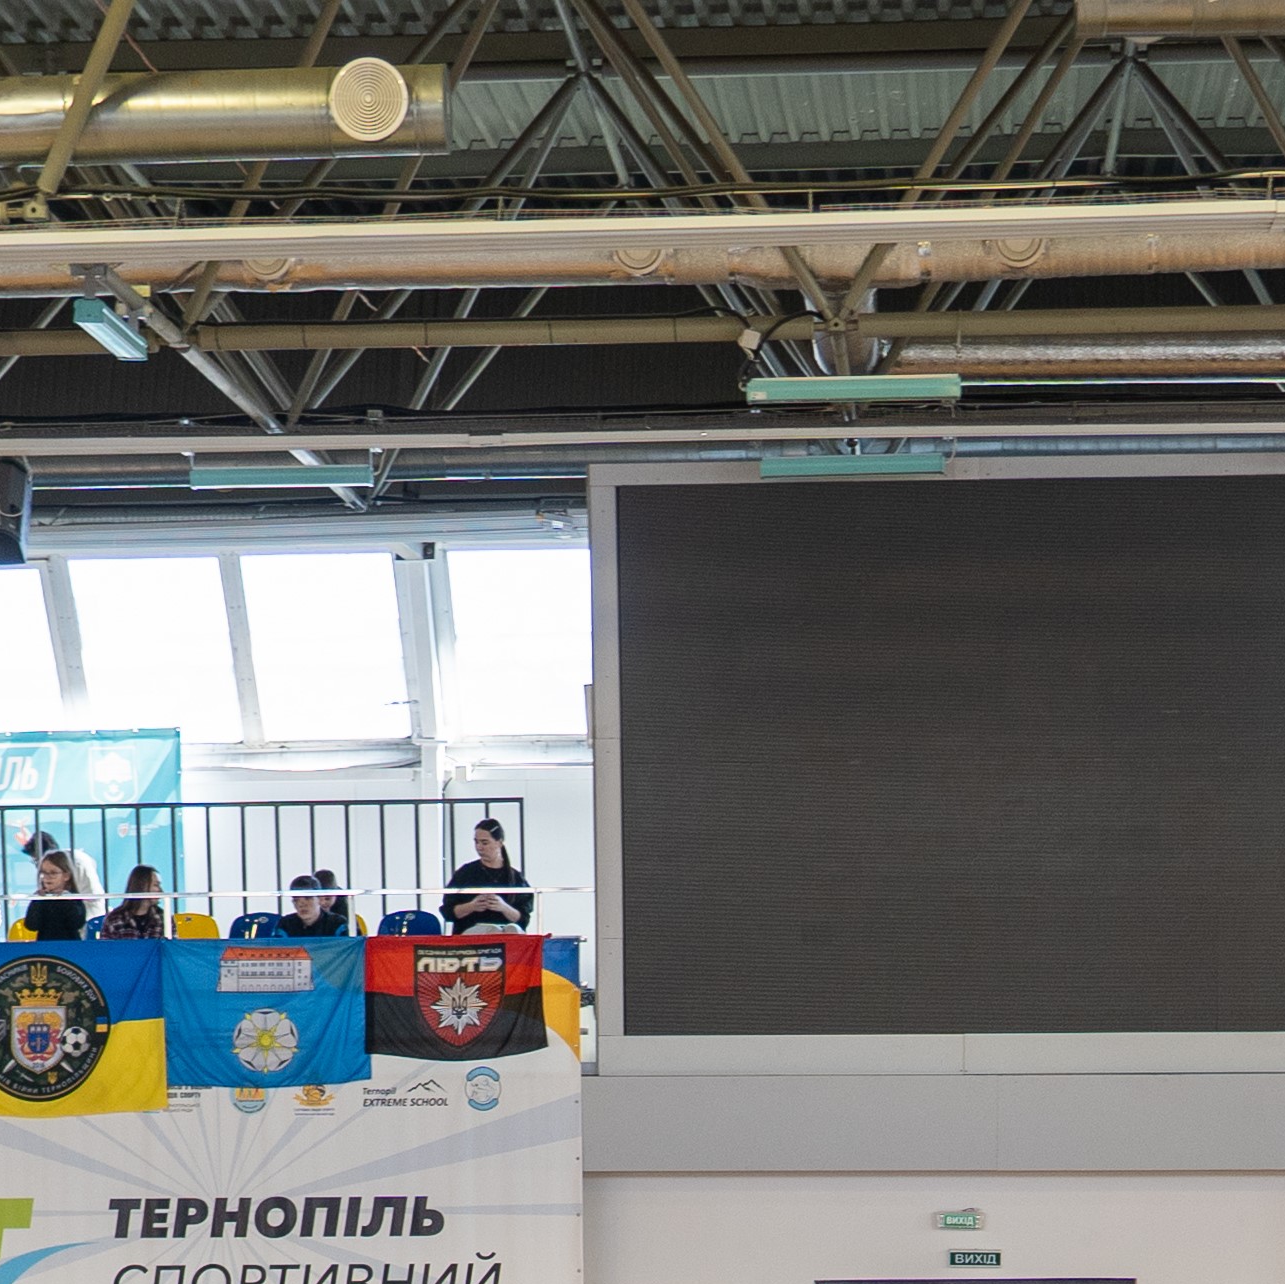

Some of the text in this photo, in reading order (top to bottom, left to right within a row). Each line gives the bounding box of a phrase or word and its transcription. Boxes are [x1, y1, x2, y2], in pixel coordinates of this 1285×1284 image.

[362, 1087, 397, 1096] Ternopil
[363, 1098, 449, 1107] EXTREME SCHOOL
[108, 1195, 446, 1240] ТЕРНОПІЛЬ
[946, 1215, 974, 1226] ВИХІД
[954, 1253, 997, 1265] ВИХІД
